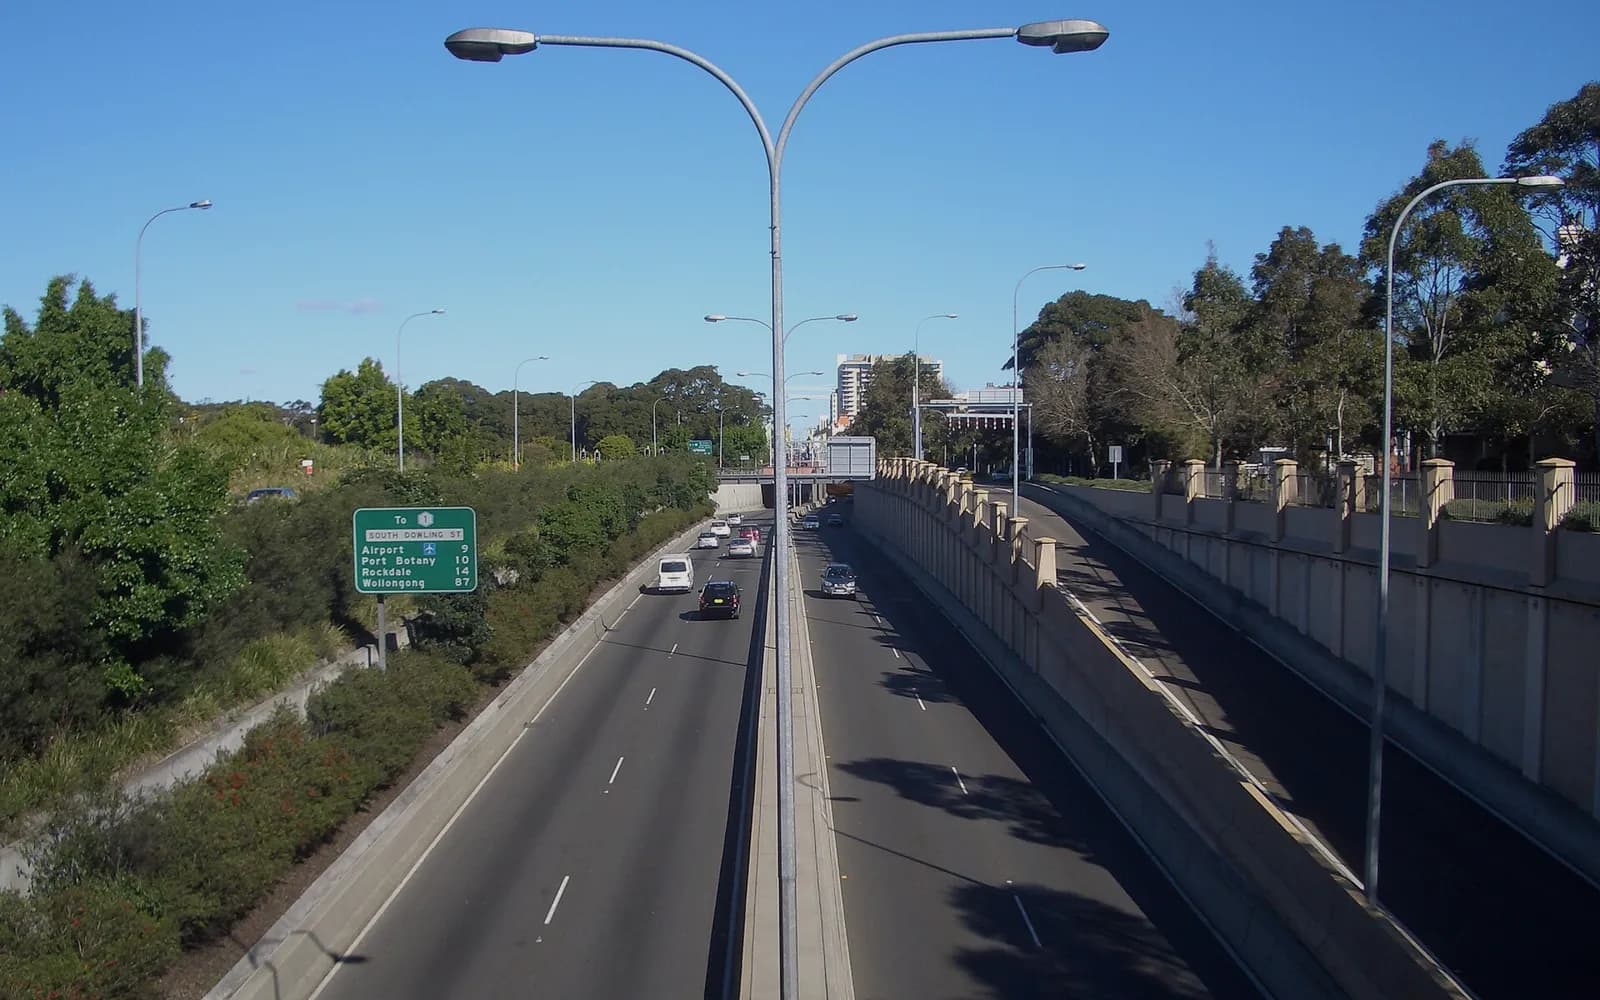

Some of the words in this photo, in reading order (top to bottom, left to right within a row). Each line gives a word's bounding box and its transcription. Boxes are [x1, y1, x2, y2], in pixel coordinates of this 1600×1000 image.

[394, 515, 407, 525] To
[368, 531, 399, 539] SOUTH
[404, 530, 444, 538] DOWLING
[450, 530, 461, 538] ST
[361, 545, 404, 556] Airport
[461, 544, 469, 553] 9
[361, 557, 387, 566] Port
[396, 556, 436, 567] Botany
[455, 555, 469, 564] 10
[362, 567, 412, 576] Rockdale
[455, 566, 470, 576] 14
[362, 578, 425, 589] Wollongong
[455, 577, 470, 587] 87
